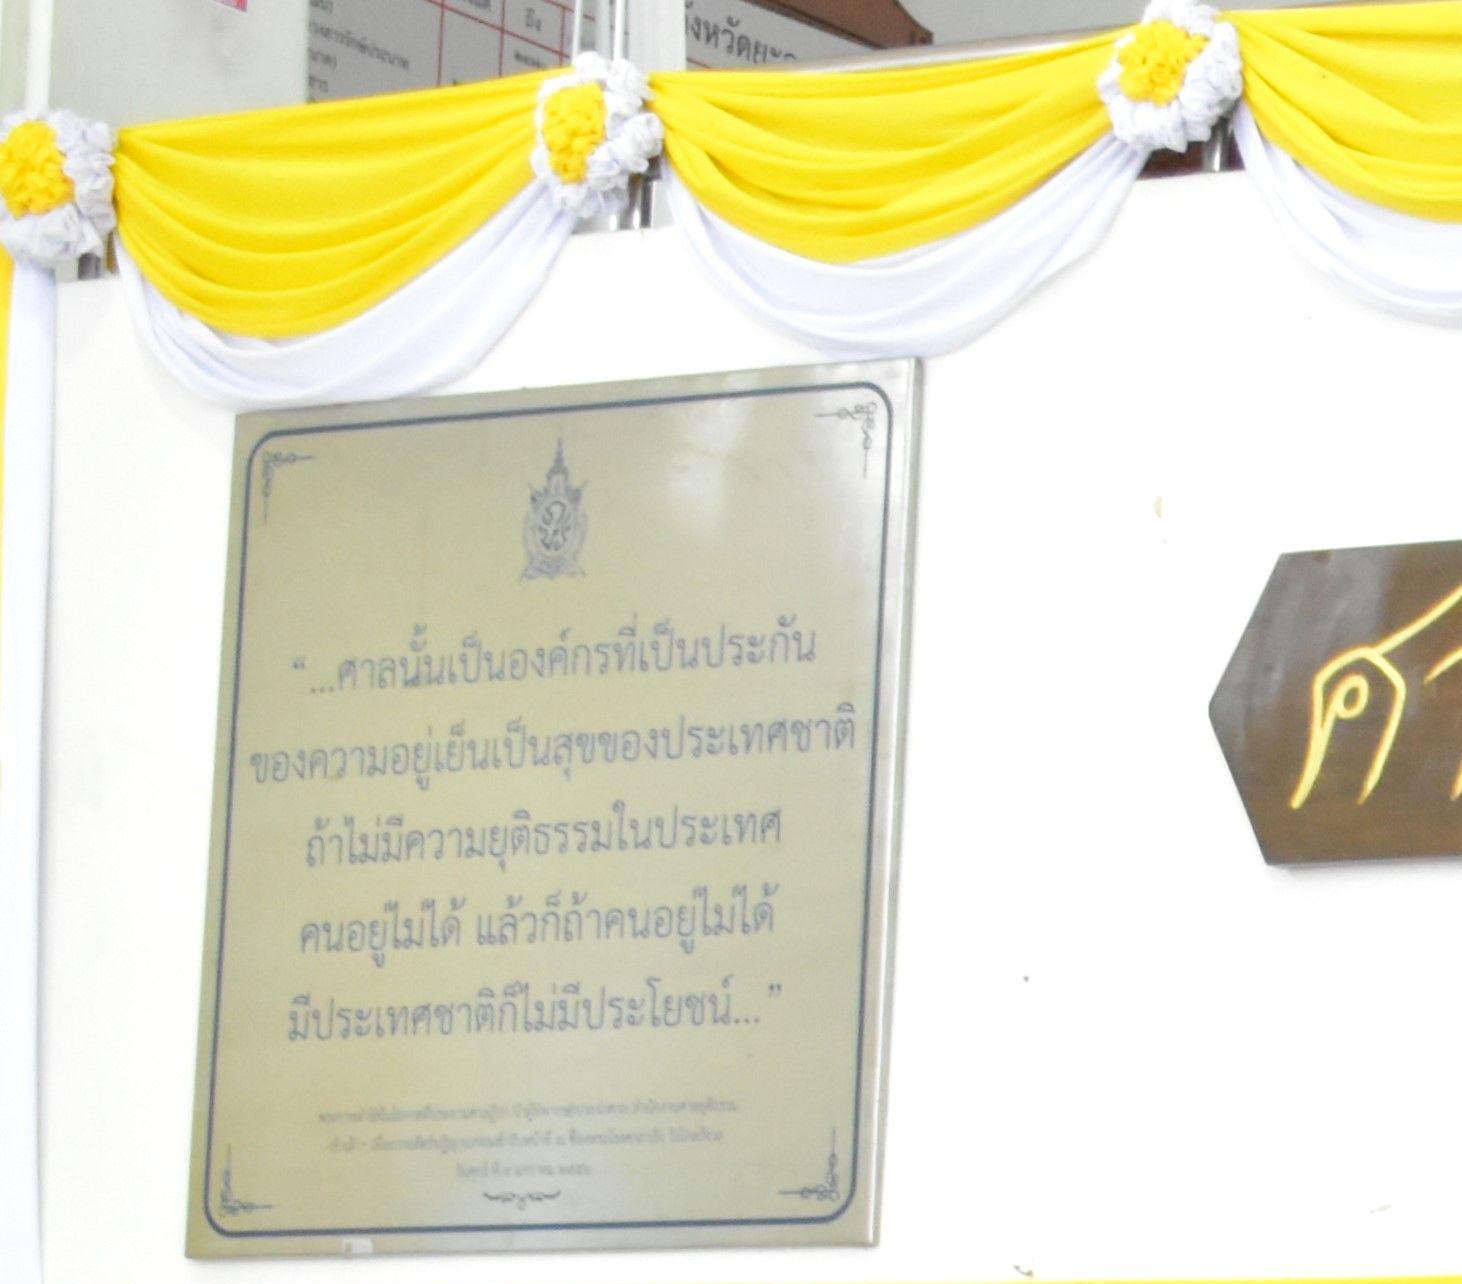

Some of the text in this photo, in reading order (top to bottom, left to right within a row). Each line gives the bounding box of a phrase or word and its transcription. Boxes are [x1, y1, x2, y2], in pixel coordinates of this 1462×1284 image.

[250, 703, 856, 790] ของความอยู่เย็นเป็นสุขของประเทศชาติ
[306, 801, 783, 870] ถ้าไม่มีความยุติธรรมในประเทศ
[300, 884, 776, 967] คนอยู่ไม่ได้ แล้วก็ถ้าคนอยู่ไม่ได้
